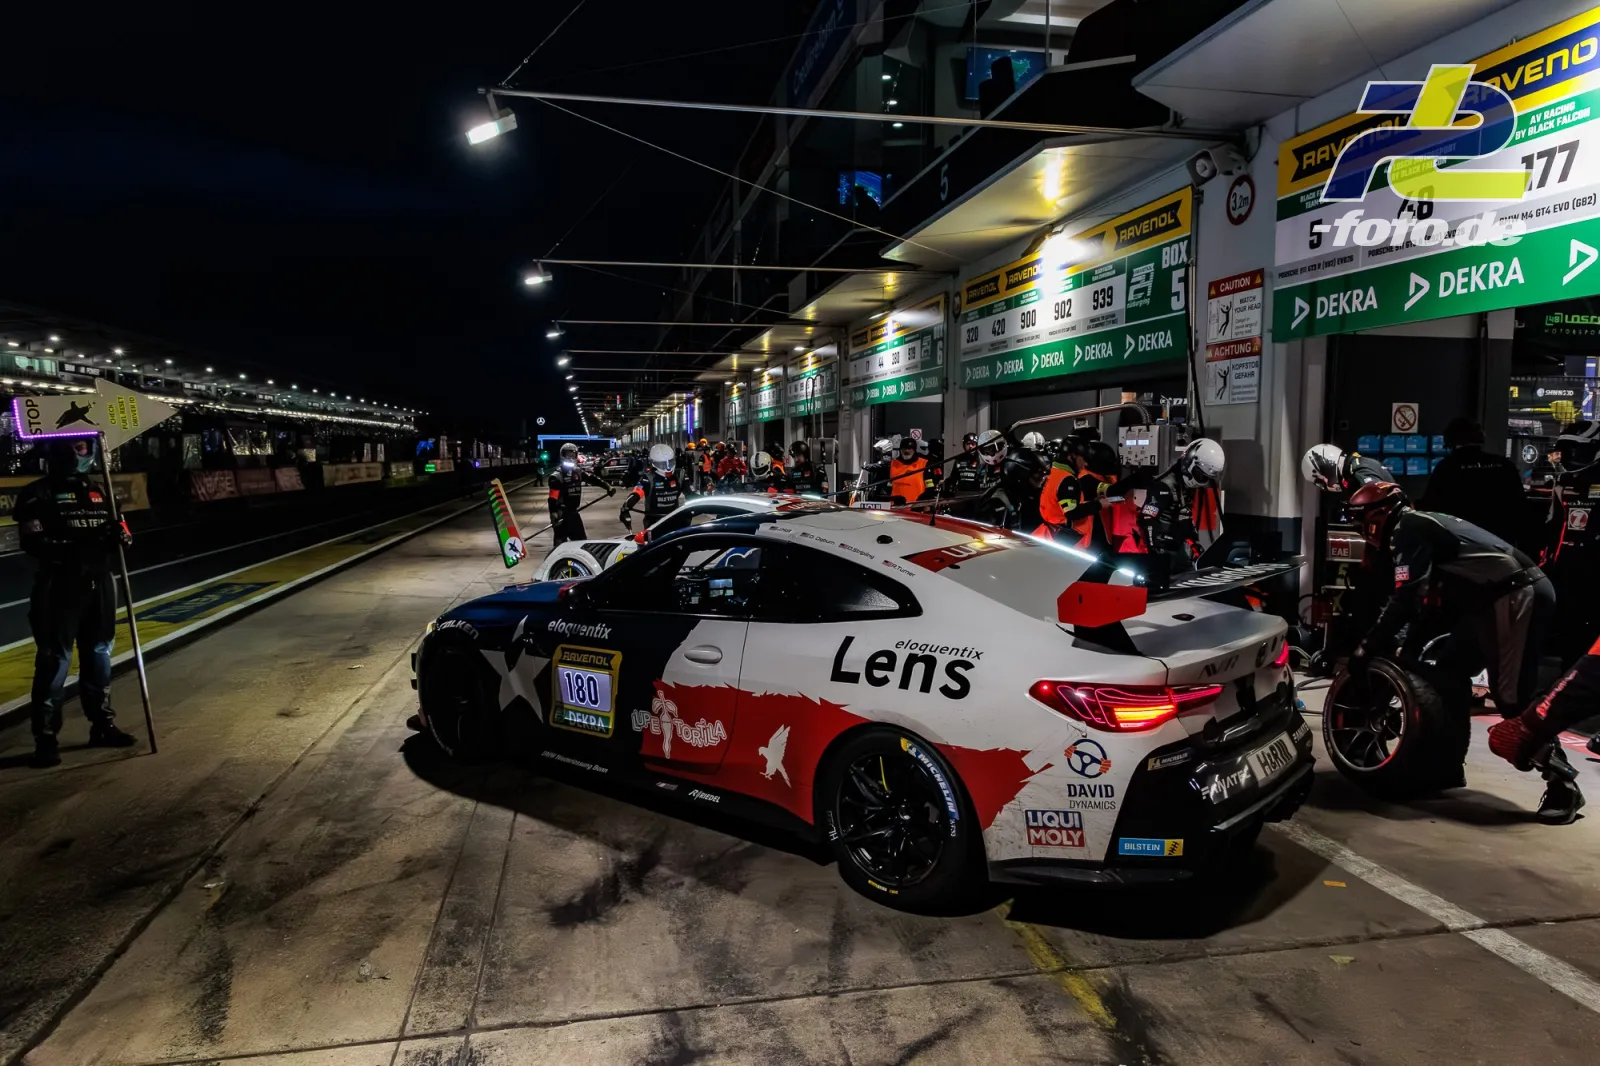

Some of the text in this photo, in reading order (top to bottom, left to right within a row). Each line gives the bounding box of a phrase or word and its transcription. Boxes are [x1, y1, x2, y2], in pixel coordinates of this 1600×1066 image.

[1515, 107, 1591, 140] BY BLACK FALCON
[1530, 101, 1576, 125] AV RACING
[1521, 139, 1580, 192] 177
[940, 165, 949, 201] 5
[1397, 185, 1434, 221] 48
[1521, 210, 1534, 221] M4
[1535, 206, 1551, 217] GT4
[1553, 201, 1570, 213] EVO
[1119, 211, 1176, 243] RAVENOL
[1309, 218, 1323, 250] 5
[1162, 239, 1189, 270] BOX
[1008, 263, 1042, 285] RAVENO
[1220, 276, 1251, 293] CAUTION
[1439, 257, 1525, 298] DEKRA
[968, 283, 998, 300] RAVENOL
[1092, 285, 1114, 311] 939
[1170, 267, 1186, 311] 5
[1054, 298, 1072, 321] 902
[1234, 304, 1247, 314] YOUR
[1316, 285, 1378, 319] DEKRA
[991, 317, 1006, 337] 420
[1020, 309, 1037, 330] 900
[1565, 314, 1600, 325] LOSC
[966, 325, 979, 344] 320
[1138, 330, 1173, 352] DEKRA
[1544, 328, 1600, 336] MOTORSPO
[1040, 350, 1065, 369] DEKRA
[1084, 337, 1113, 361] DEKRA
[1214, 342, 1251, 357] ACHTUNG
[972, 365, 990, 380] DEKRA
[1003, 358, 1024, 375] DEKRA
[1234, 371, 1255, 380] GEFAHR
[25, 398, 42, 436] STOP
[107, 403, 117, 425] CHECK
[117, 396, 129, 430] FUEL RESET
[130, 404, 139, 427] DRIVER
[1331, 547, 1349, 557] EAE
[548, 619, 612, 640] eloquentix
[562, 651, 610, 667] RAVENOL
[895, 638, 984, 661] eloquentix
[830, 636, 976, 700] Lens
[564, 671, 600, 707] 180
[568, 710, 607, 733] DEKRA
[631, 709, 727, 747] LUPE TORTILLA
[917, 753, 956, 812] MICHELIN
[1067, 784, 1115, 798] DAVID
[1069, 801, 1116, 810] DYNAMICS
[1027, 811, 1080, 828] LIQUI
[1029, 829, 1083, 846] MOLY
[1124, 842, 1161, 851] BILSTEIN
